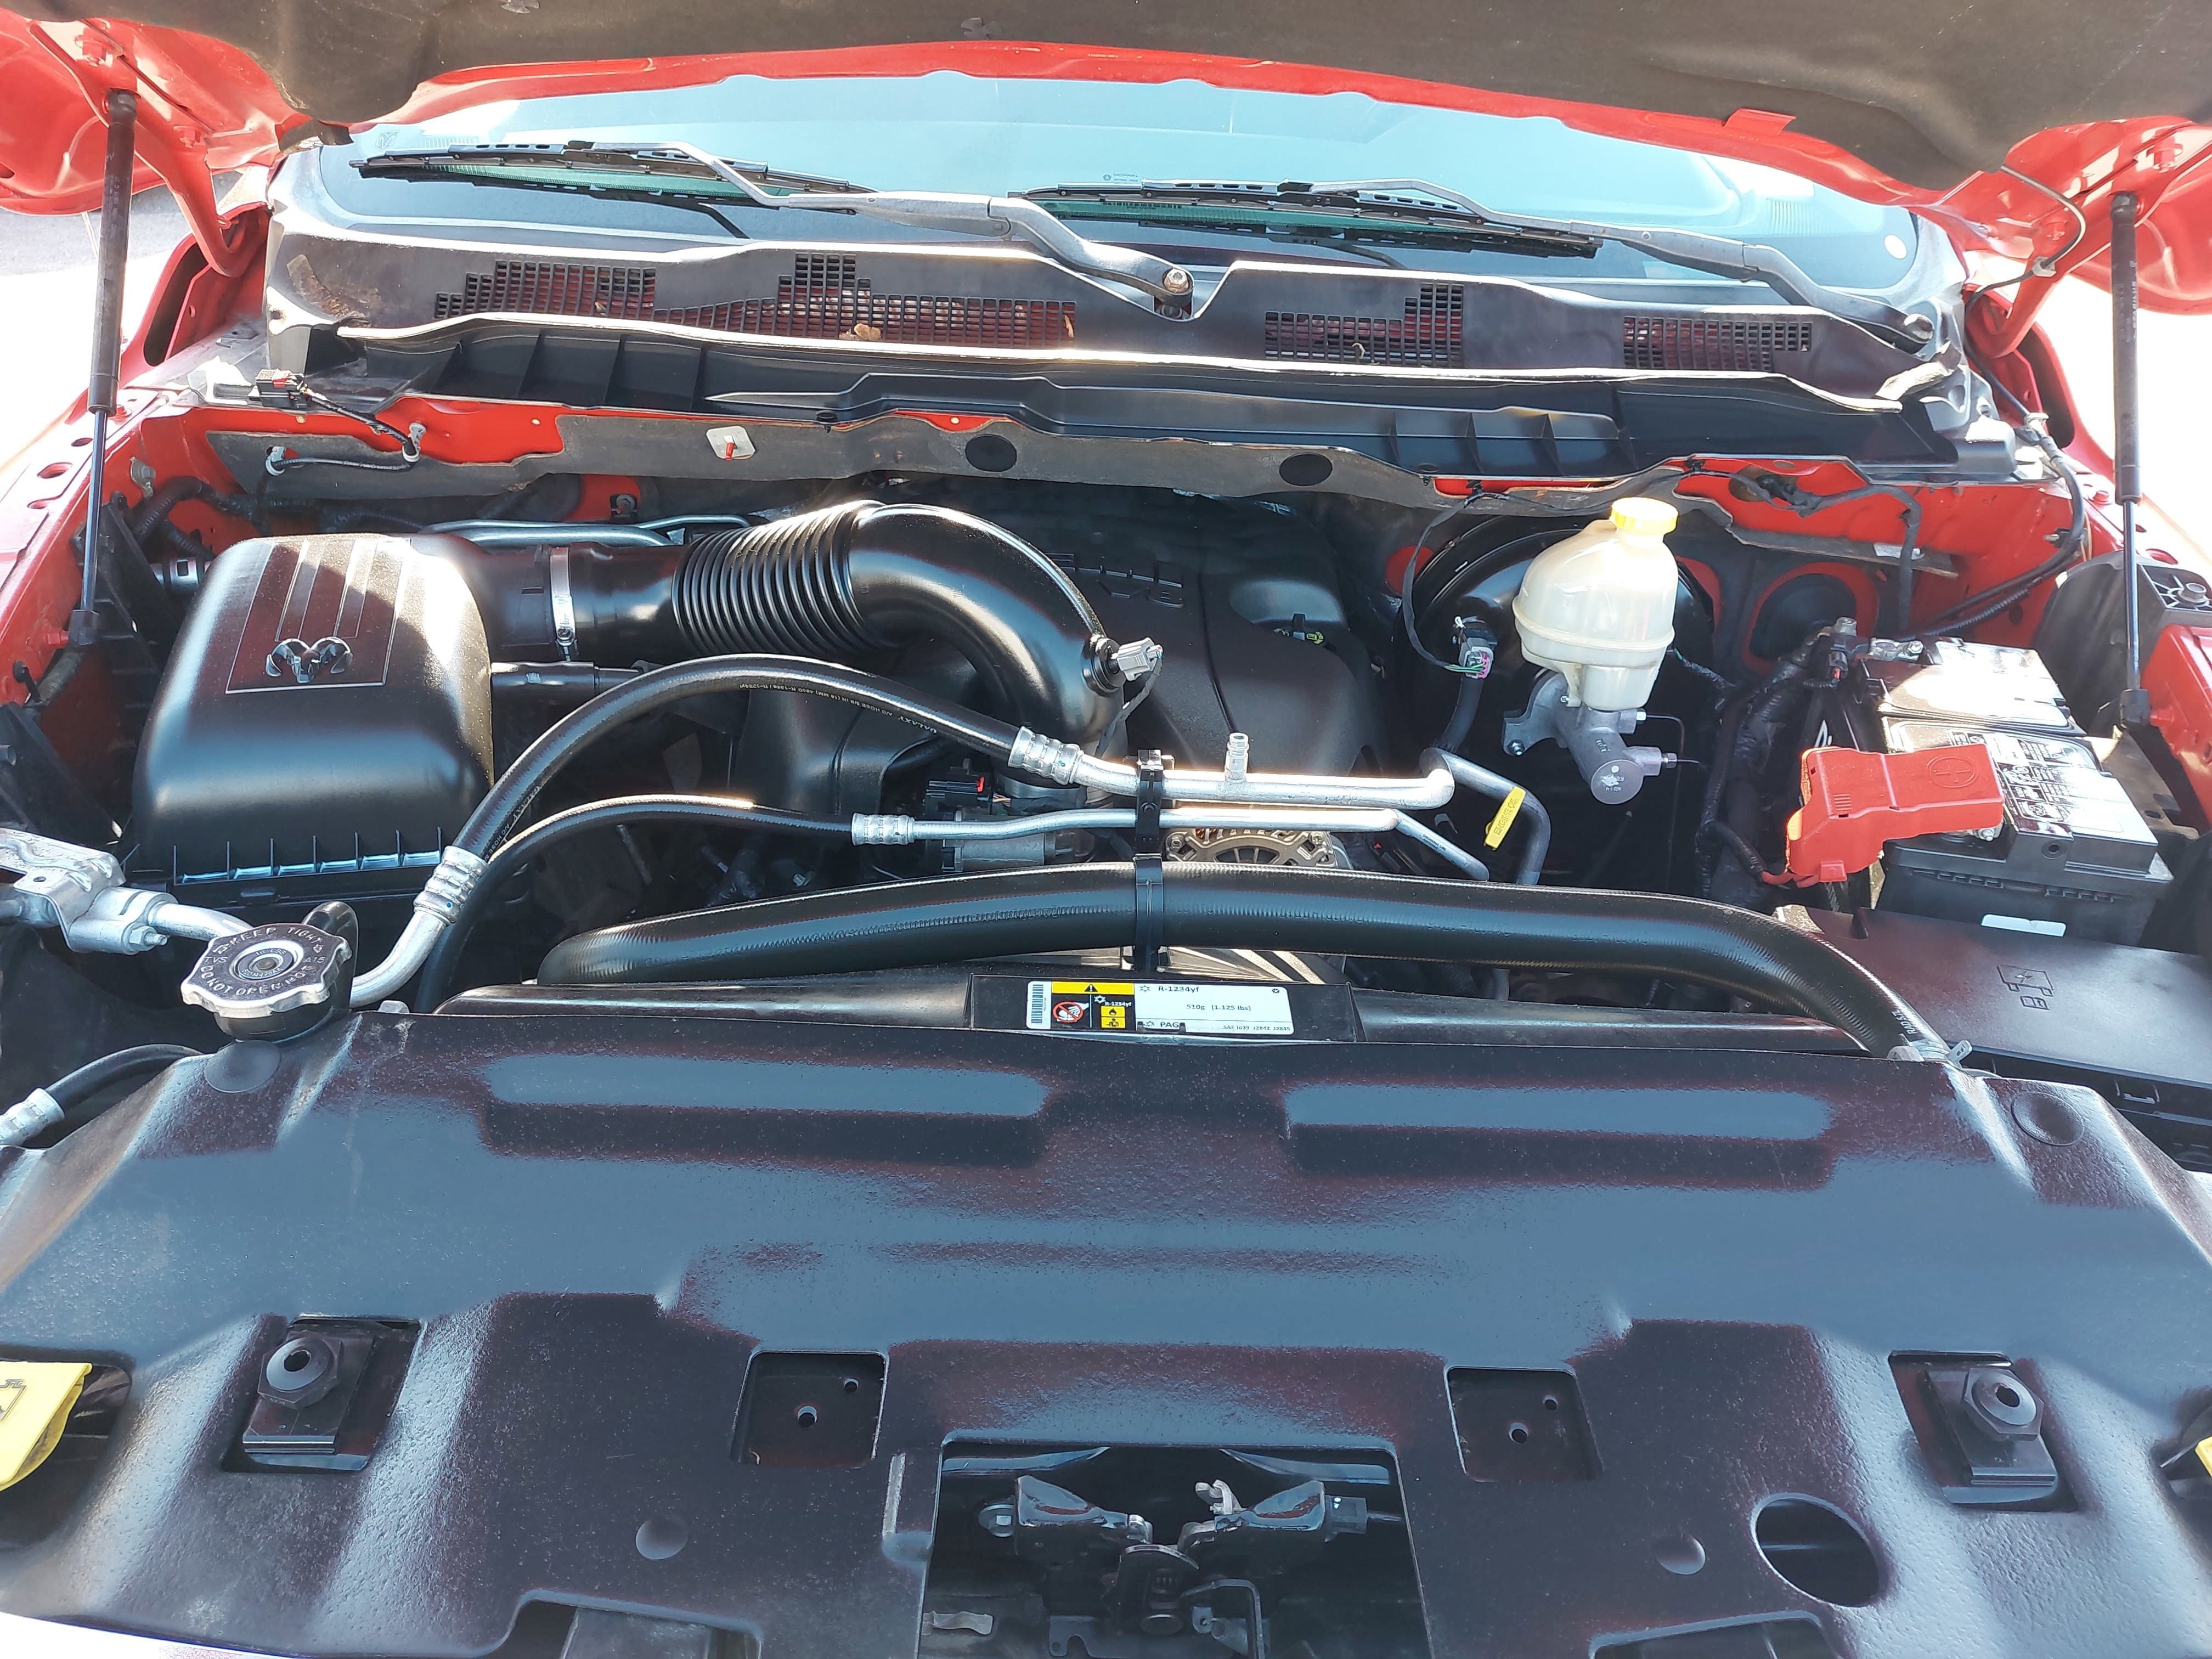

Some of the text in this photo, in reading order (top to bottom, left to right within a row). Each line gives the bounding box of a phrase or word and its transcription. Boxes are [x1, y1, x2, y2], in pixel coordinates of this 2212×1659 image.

[1493, 808, 1513, 835] ENGINE
[229, 927, 323, 945] KEEP TIGHT
[1900, 1020, 1918, 1034] RAD
